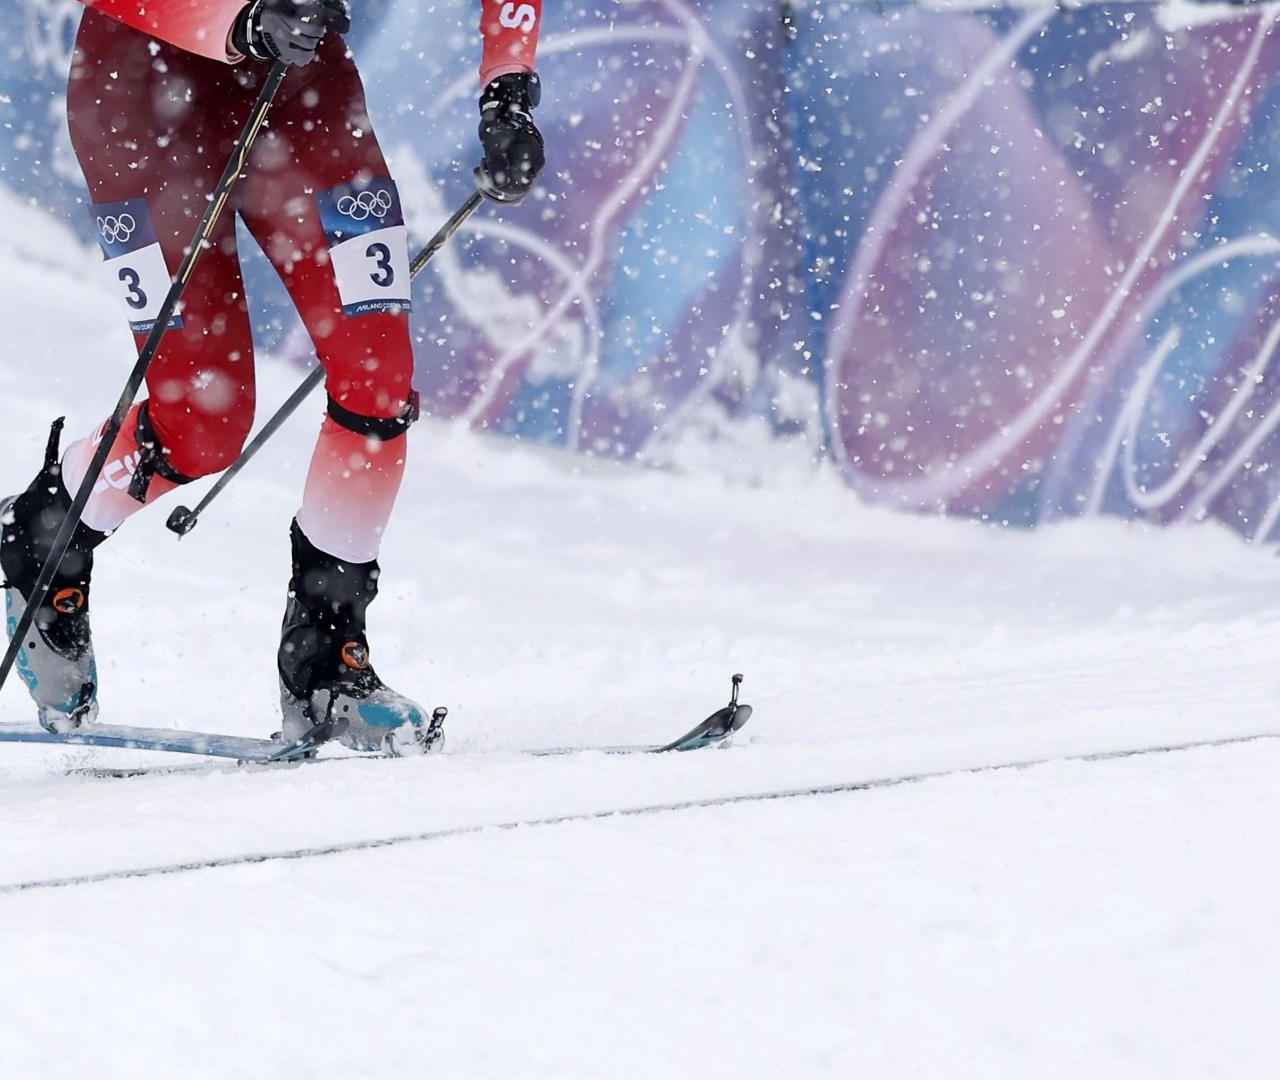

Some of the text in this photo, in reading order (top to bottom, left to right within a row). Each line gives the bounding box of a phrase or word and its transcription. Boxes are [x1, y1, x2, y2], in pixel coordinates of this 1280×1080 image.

[366, 242, 395, 287] 3
[118, 266, 148, 310] 3
[356, 303, 382, 313] MILANO
